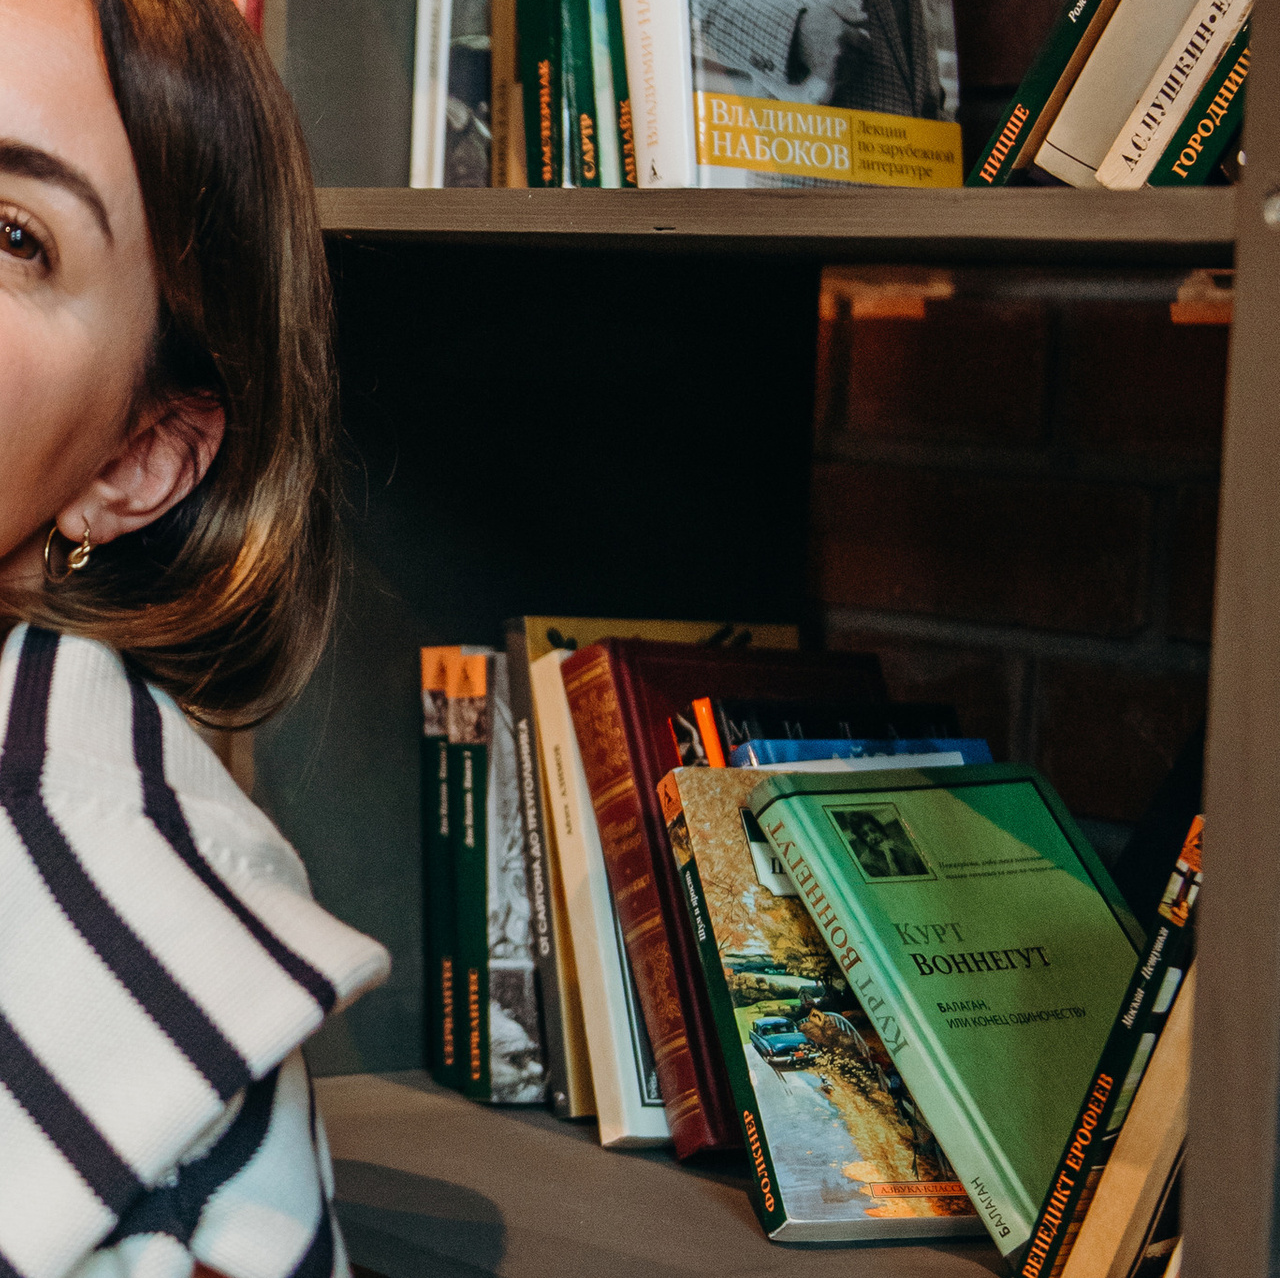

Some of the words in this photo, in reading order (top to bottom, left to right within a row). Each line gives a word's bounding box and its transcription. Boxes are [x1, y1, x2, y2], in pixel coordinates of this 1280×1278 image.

[641, 30, 659, 147] ВЛАДИМИР
[538, 59, 553, 182] ПАСТЕРНАК
[710, 99, 847, 138] ВЛАДИМИР
[858, 120, 906, 140] Лекции
[580, 113, 595, 180] САРТР
[619, 98, 637, 183] АПДАЙК
[712, 131, 849, 170] НАБОКОВ
[858, 140, 875, 154] по
[876, 142, 954, 164] зарубежной
[979, 103, 1031, 183] НИЦШЕ
[858, 160, 933, 179] литературе
[519, 720, 536, 831] ТРЕУГОЛЬНИКА
[529, 831, 541, 858] ДО
[532, 859, 547, 934] САЙГОНА
[685, 870, 699, 907] ярость
[766, 819, 863, 972] ВОННЕГУТ
[694, 907, 700, 916] и
[696, 916, 706, 941] Шум
[891, 922, 965, 945] КУРТ
[909, 946, 1051, 976] ВОННЕГУТ
[854, 974, 909, 1057] КУРТ
[937, 1000, 990, 1014] БАЛАГАН,
[945, 1017, 970, 1029] ИЛИ
[971, 1014, 1009, 1028] КОНЕЦ
[1009, 1007, 1086, 1026] ОДИНОЧЕСТВУ
[1065, 1073, 1114, 1171] ЕРОФЕЕВ
[744, 1110, 775, 1212] ФОЛКНЕР
[971, 1176, 1011, 1238] БАЛАГАН
